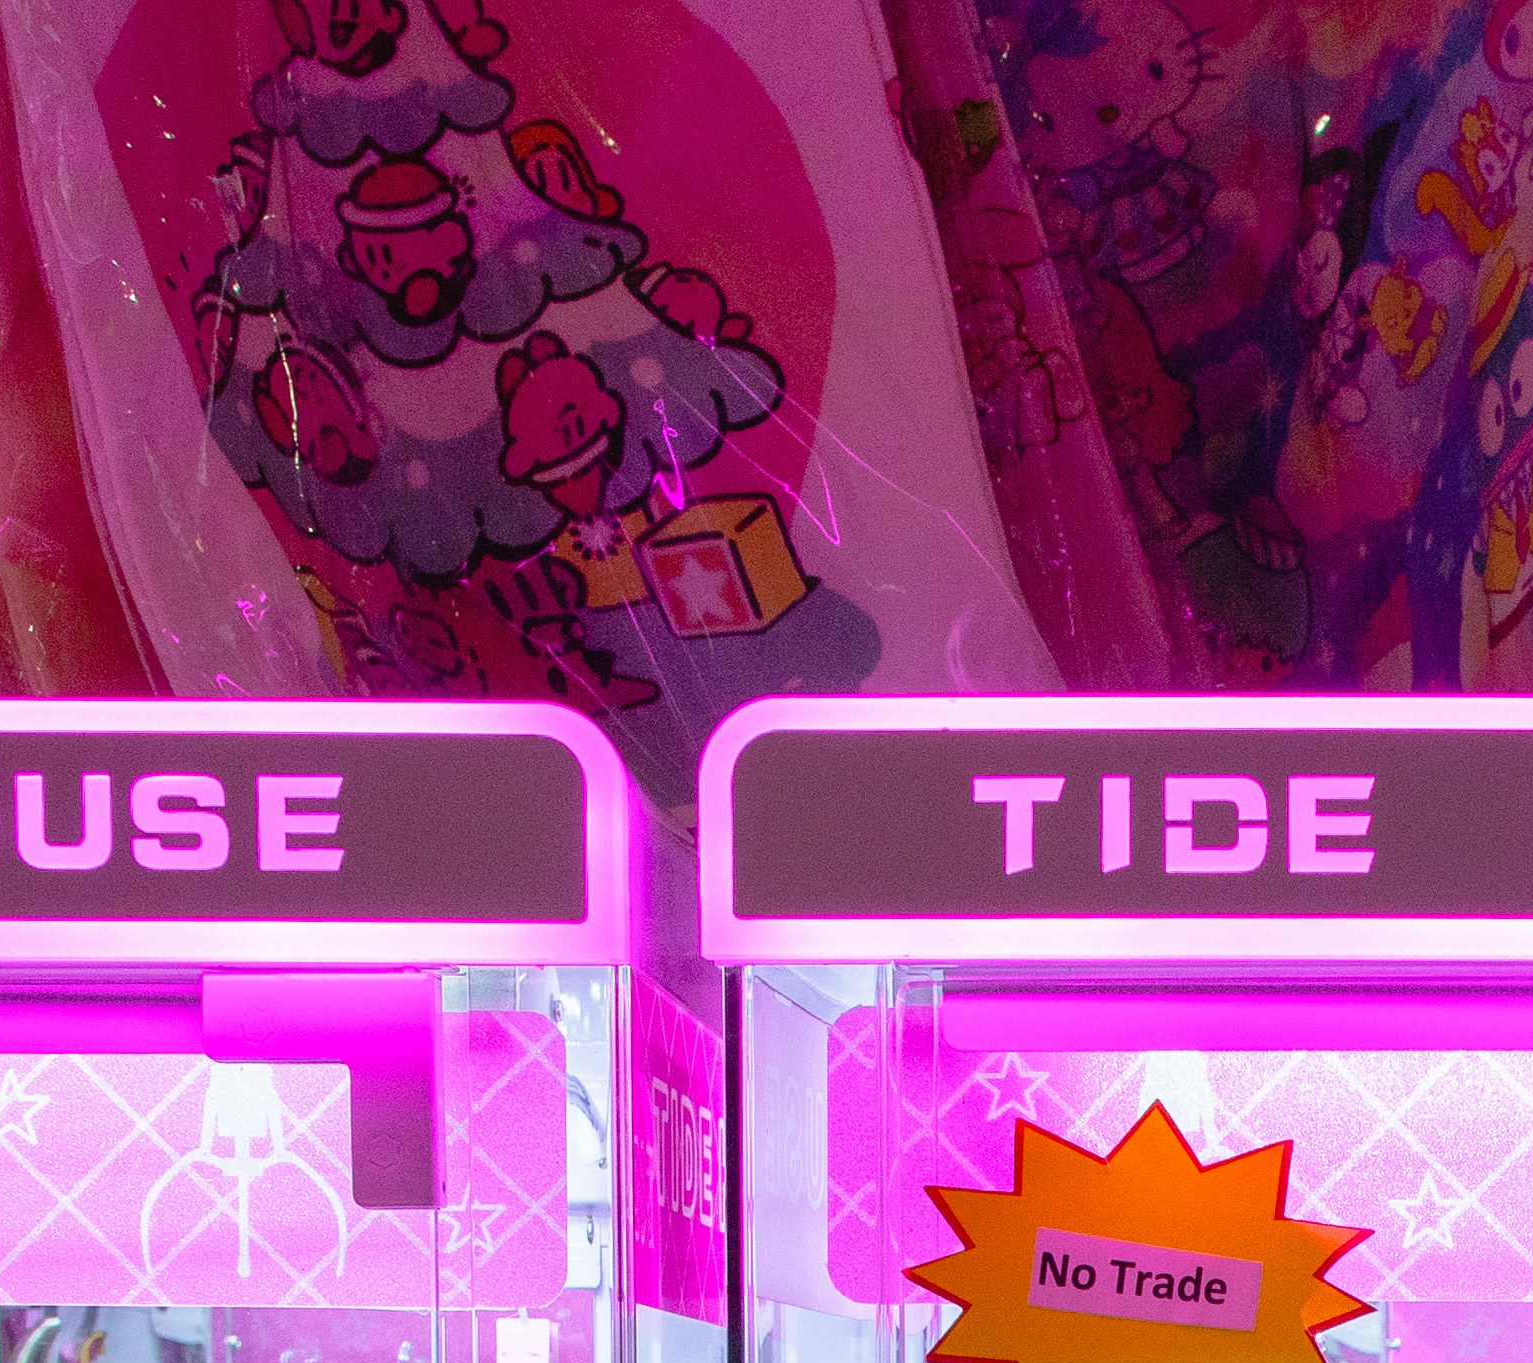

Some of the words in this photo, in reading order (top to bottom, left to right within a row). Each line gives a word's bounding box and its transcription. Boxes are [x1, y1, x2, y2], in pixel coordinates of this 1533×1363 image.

[971, 773, 1377, 877] TIDE
[1038, 1252, 1096, 1290] No
[1110, 1259, 1227, 1305] Trade
